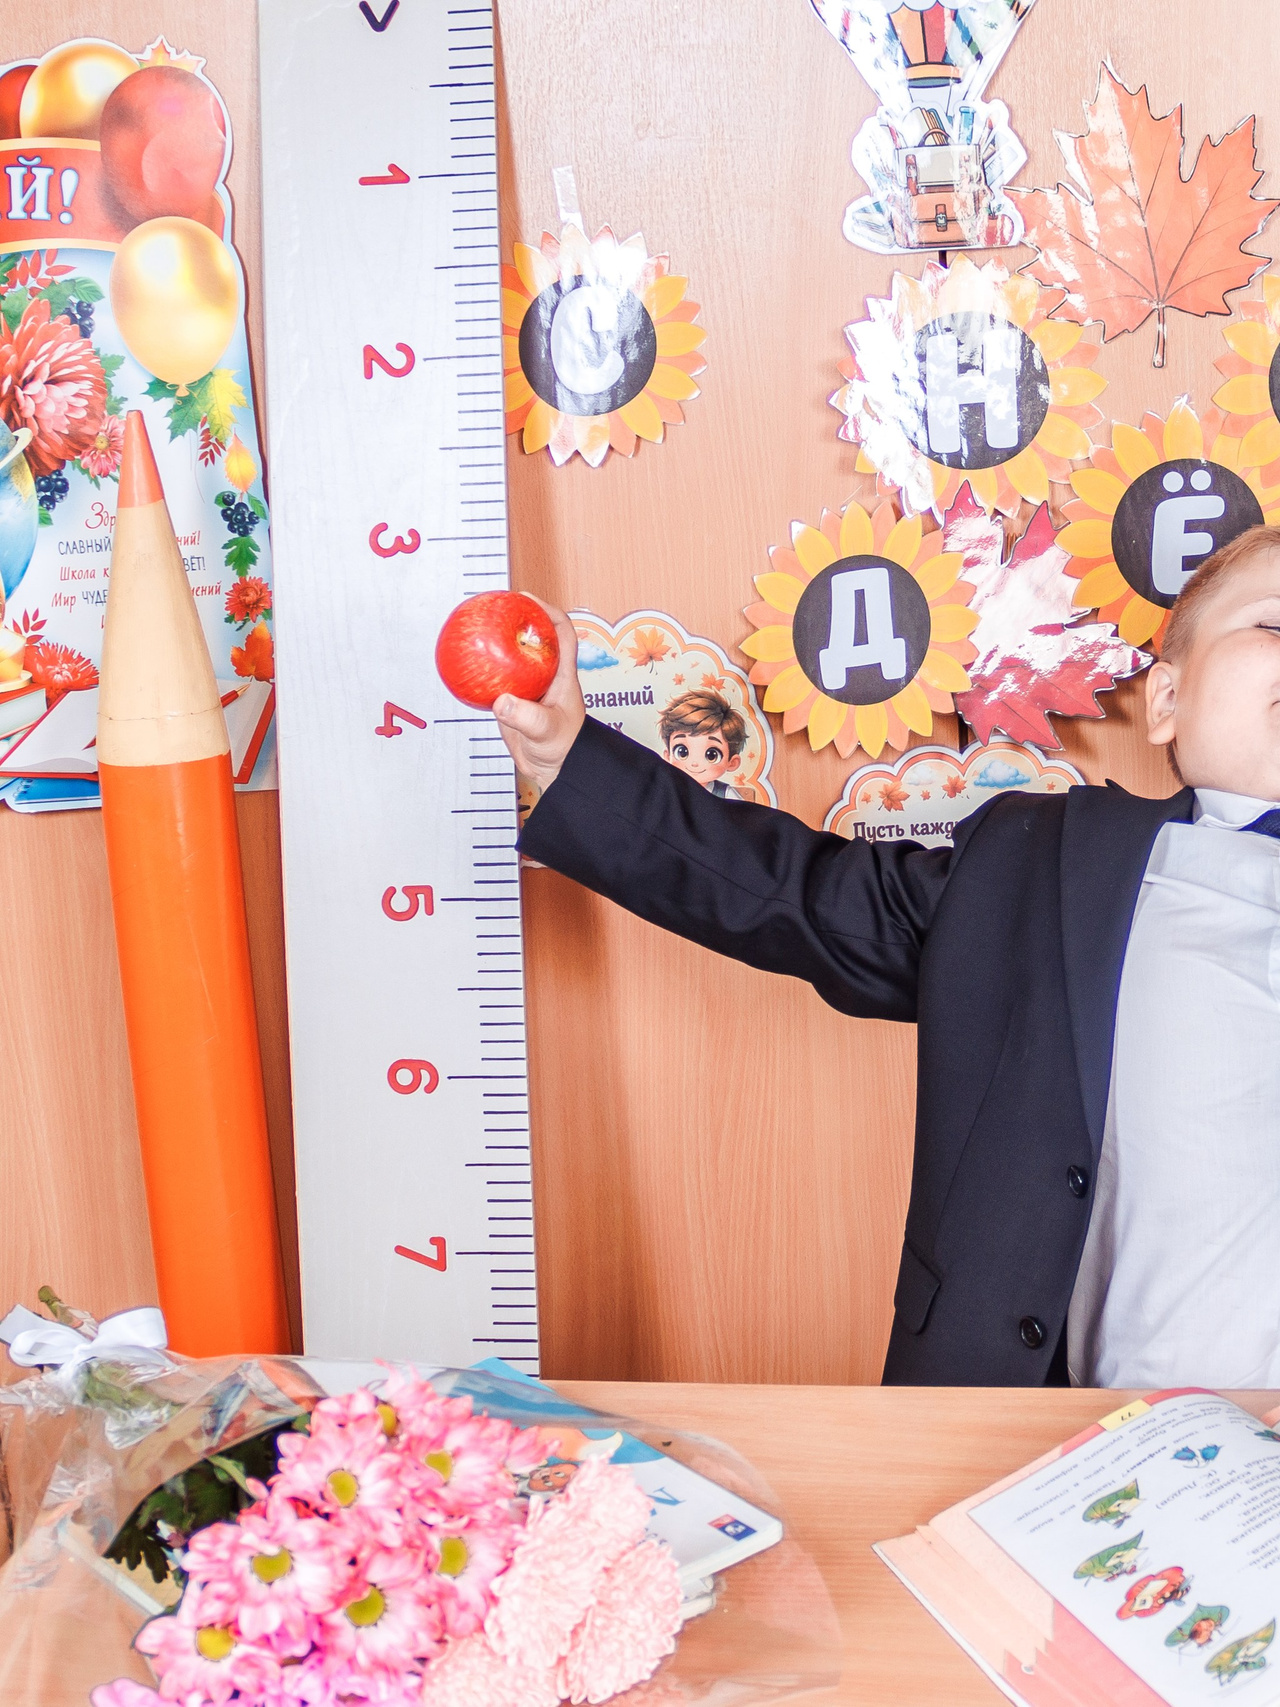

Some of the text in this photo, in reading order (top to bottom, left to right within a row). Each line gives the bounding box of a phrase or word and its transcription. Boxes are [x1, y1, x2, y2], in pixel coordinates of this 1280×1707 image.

[0, 155, 80, 226] Й!
[550, 284, 625, 396] С
[363, 342, 415, 381] 2
[925, 328, 1019, 455] Н
[58, 536, 113, 556] СЛАВНЫЙ
[369, 521, 421, 558] 3
[1151, 470, 1226, 596] Ё
[59, 565, 96, 582] Школа
[183, 556, 207, 572] ВЁТ!
[51, 581, 222, 613] Мир ЧУДЕ ений
[818, 567, 908, 691] Д
[584, 684, 655, 709] знаний
[374, 701, 427, 740] 4
[852, 820, 959, 844] Пусть кажд
[381, 885, 435, 922] 5
[387, 1058, 440, 1095] 6
[394, 1236, 447, 1272] 7
[1119, 1411, 1134, 1421] 77
[1083, 1434, 1123, 1463] русского
[1121, 1445, 1167, 1478] алфавит?
[1081, 1479, 1116, 1502] Назови
